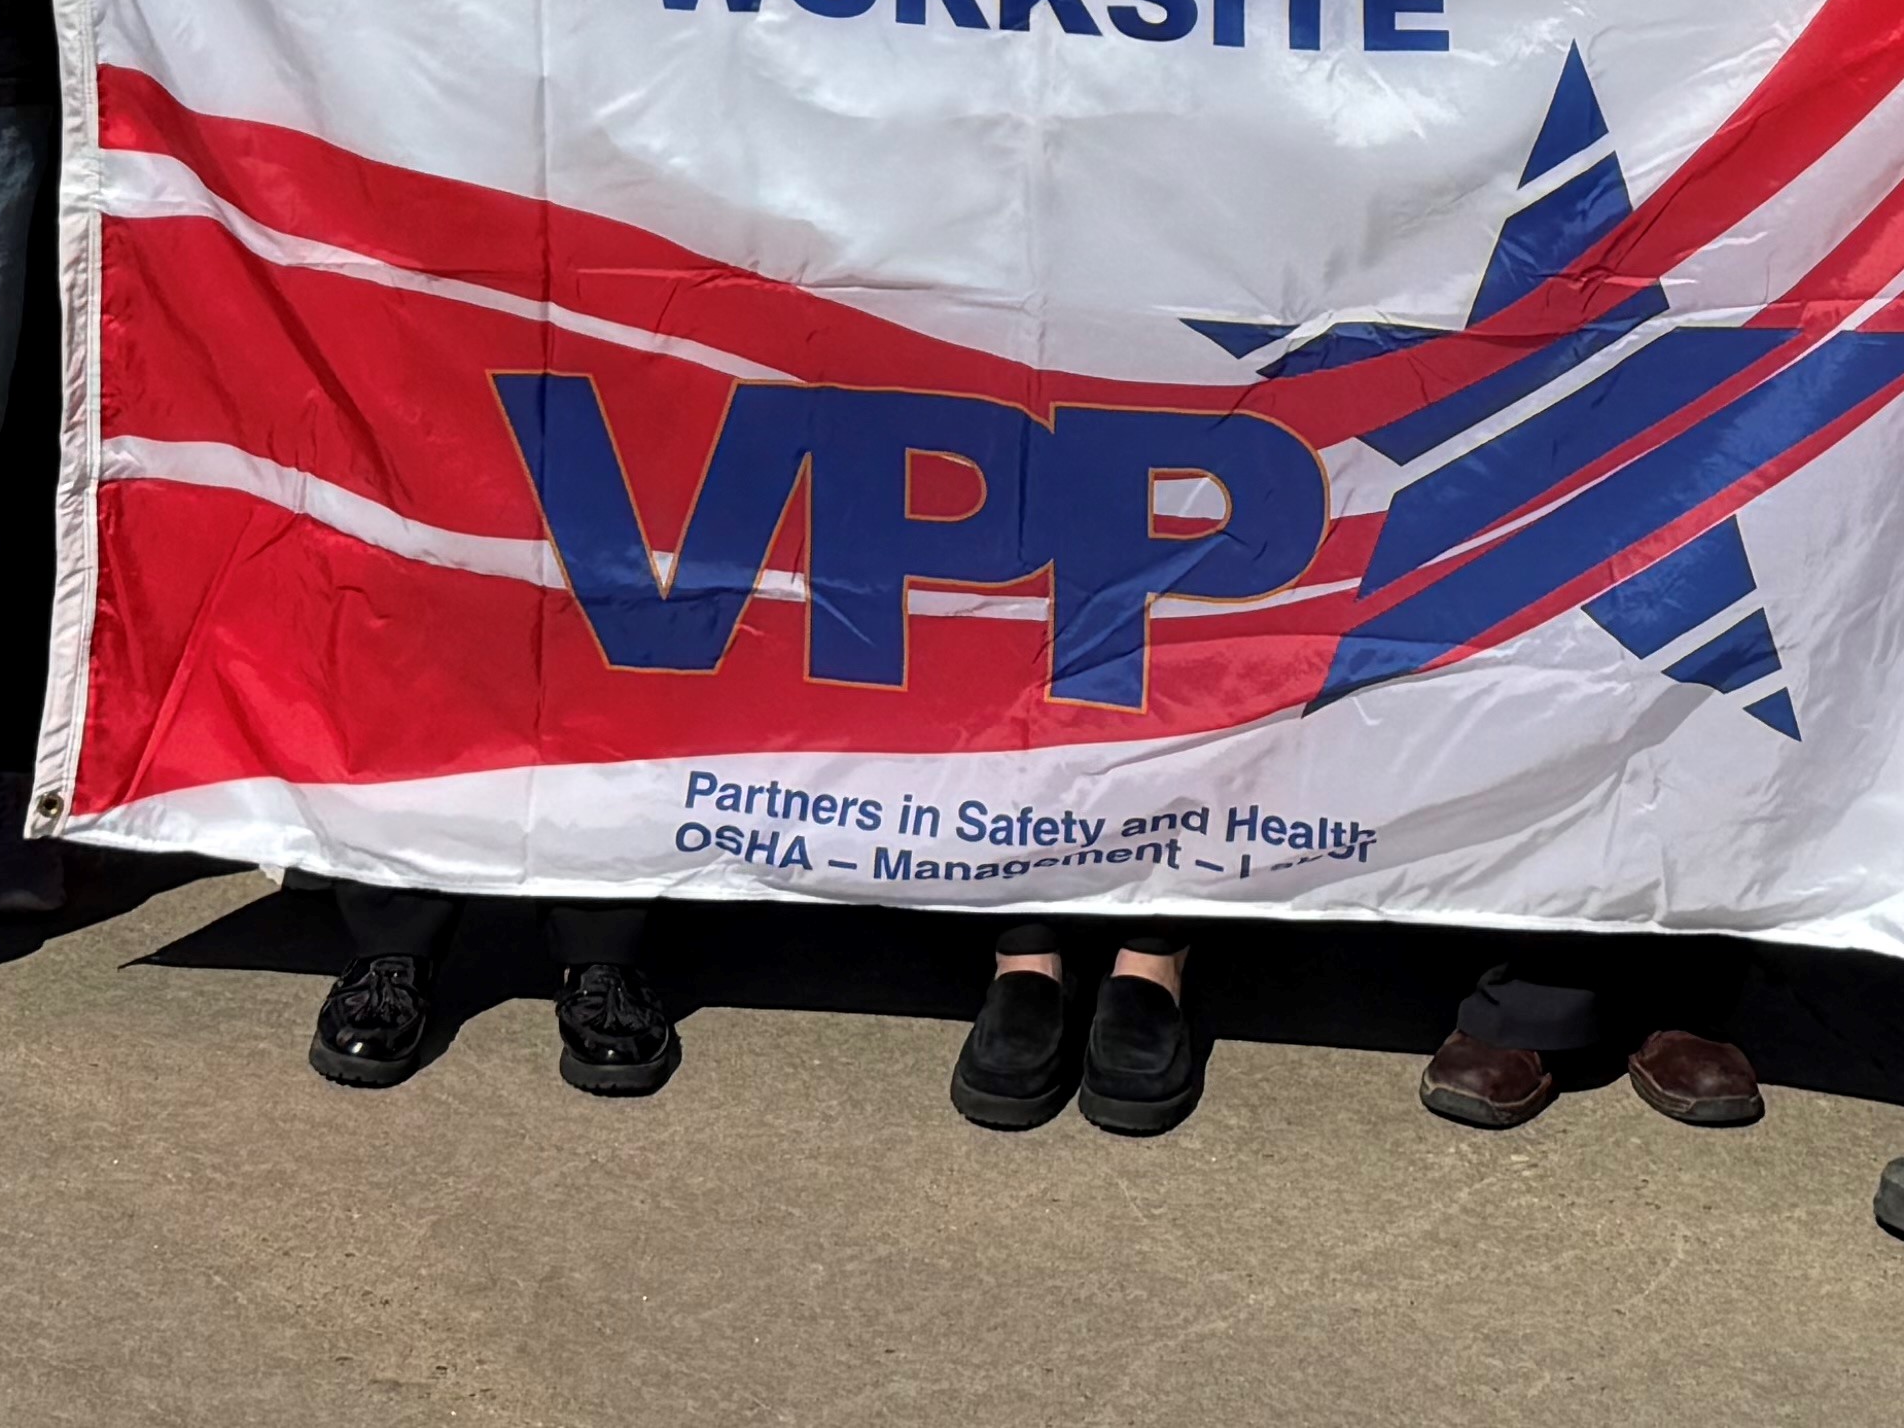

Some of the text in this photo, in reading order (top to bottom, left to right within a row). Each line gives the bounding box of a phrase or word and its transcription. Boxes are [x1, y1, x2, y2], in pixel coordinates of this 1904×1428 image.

[485, 370, 1331, 714] VPP
[685, 770, 1377, 850] Partners in Safety and Health
[675, 821, 814, 871] OSHA
[873, 838, 1183, 881] Management
